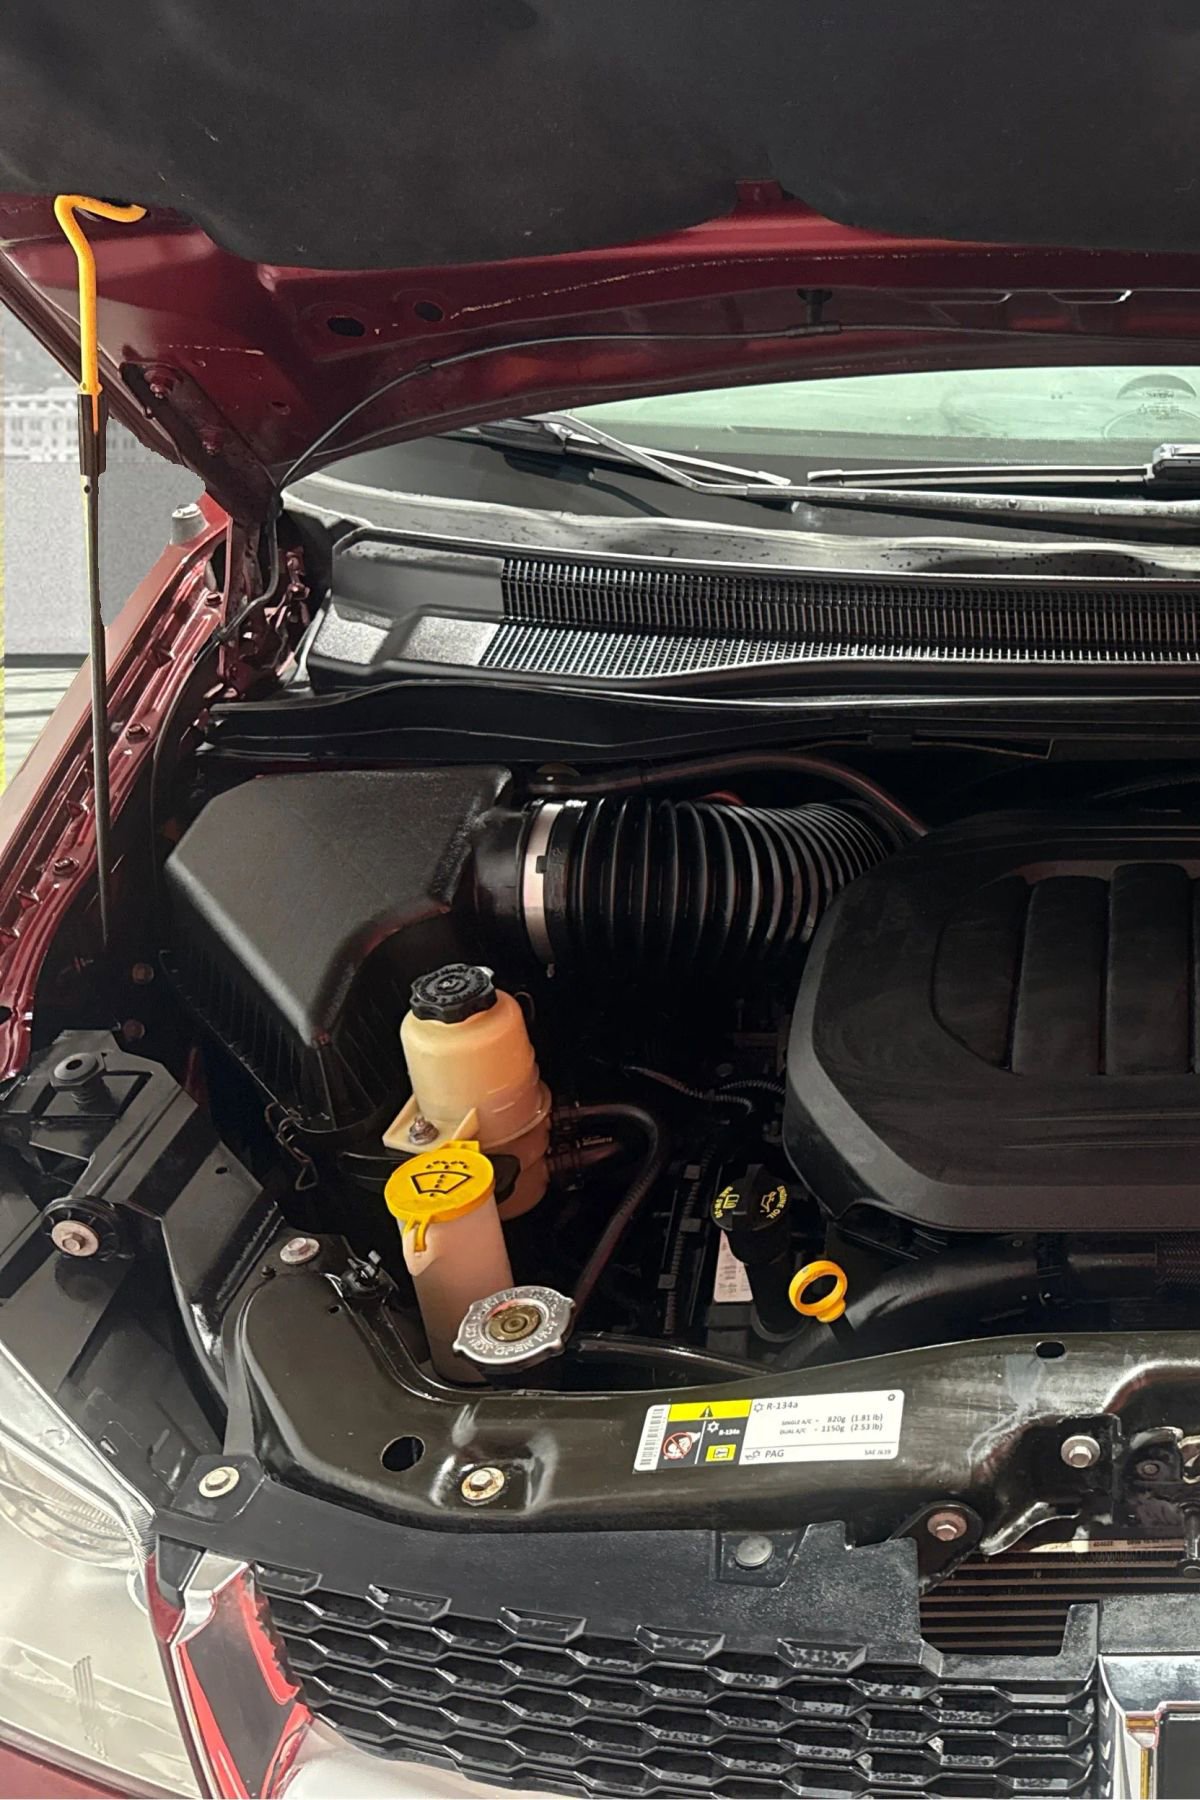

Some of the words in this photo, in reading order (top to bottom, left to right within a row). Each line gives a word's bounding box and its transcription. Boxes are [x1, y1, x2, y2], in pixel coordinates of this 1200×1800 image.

[766, 1208, 781, 1219] OIL
[766, 1401, 799, 1411] R-134a
[764, 1449, 785, 1459] PAG
